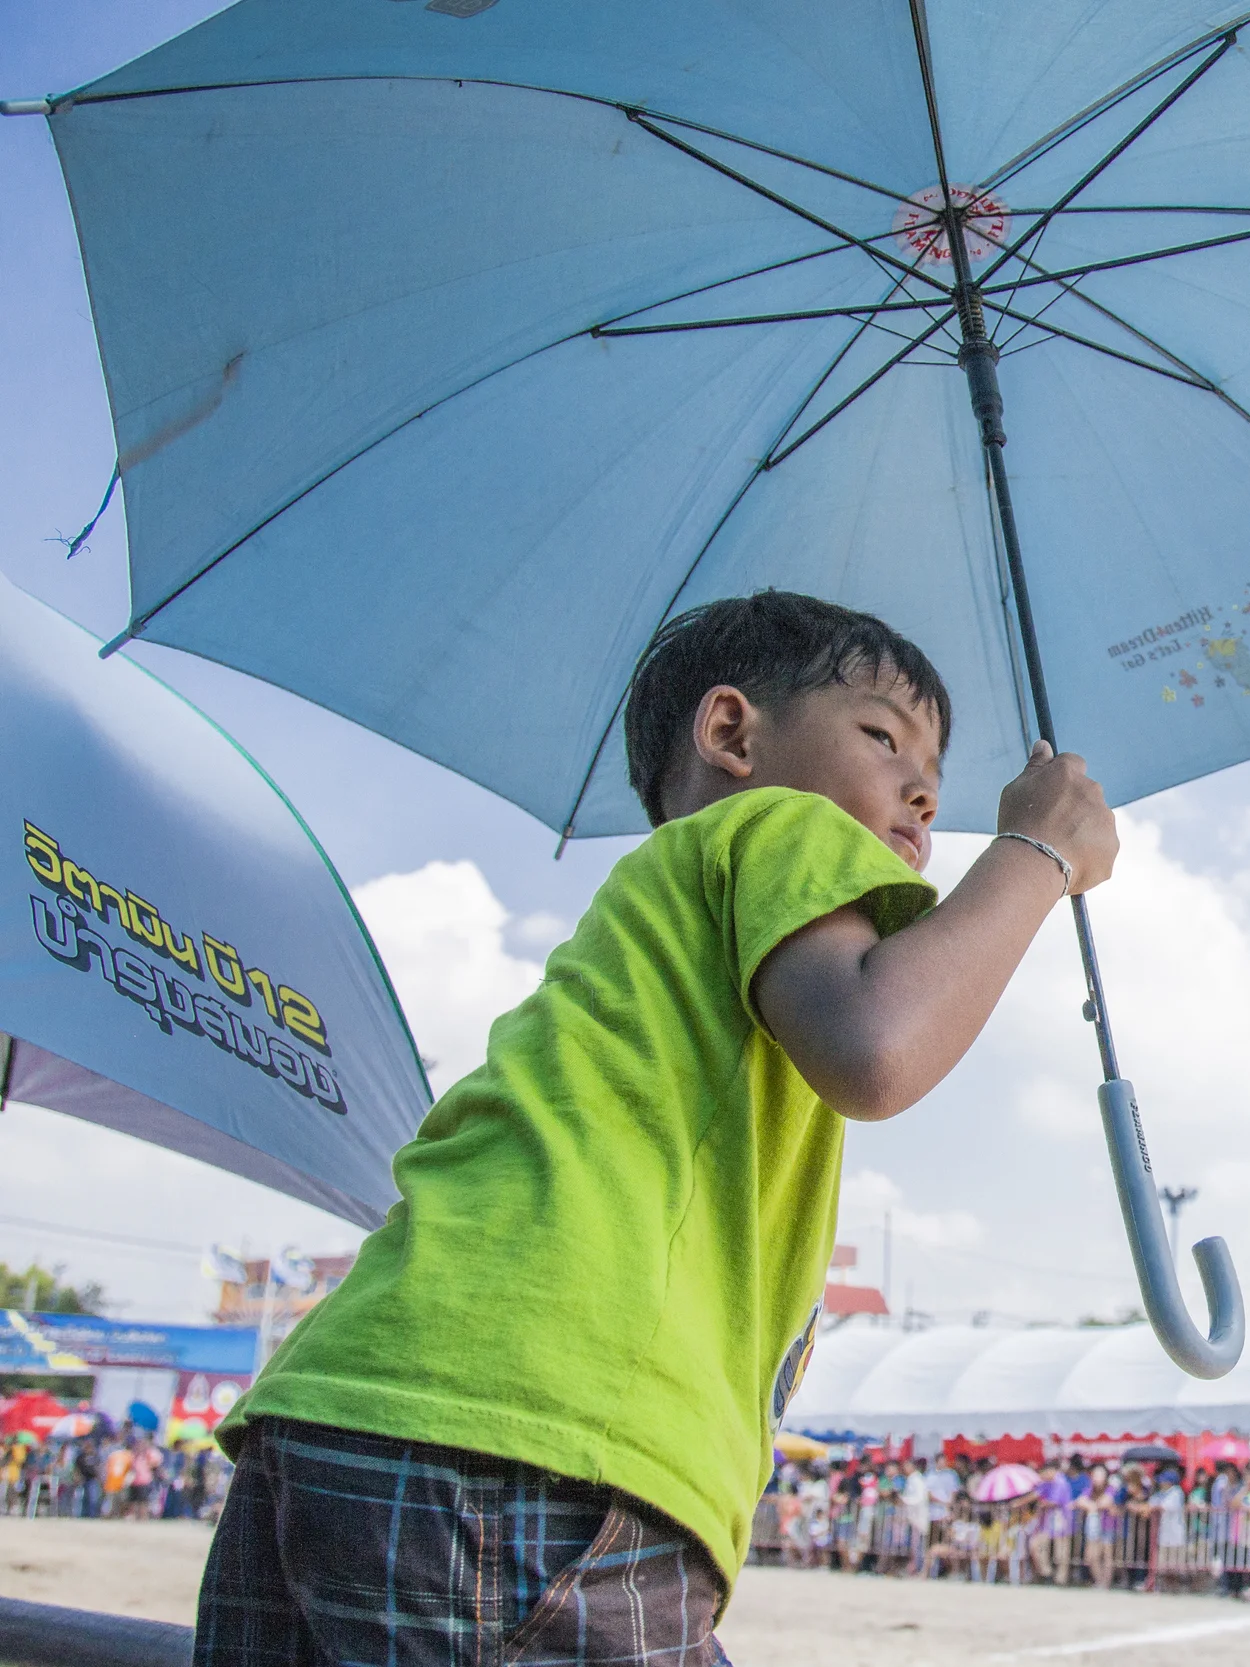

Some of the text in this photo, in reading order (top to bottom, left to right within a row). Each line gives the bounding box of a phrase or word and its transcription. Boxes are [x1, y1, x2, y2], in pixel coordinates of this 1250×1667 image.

[23, 818, 205, 982] วิตามิน
[29, 893, 348, 1115] บำรุงสมอง
